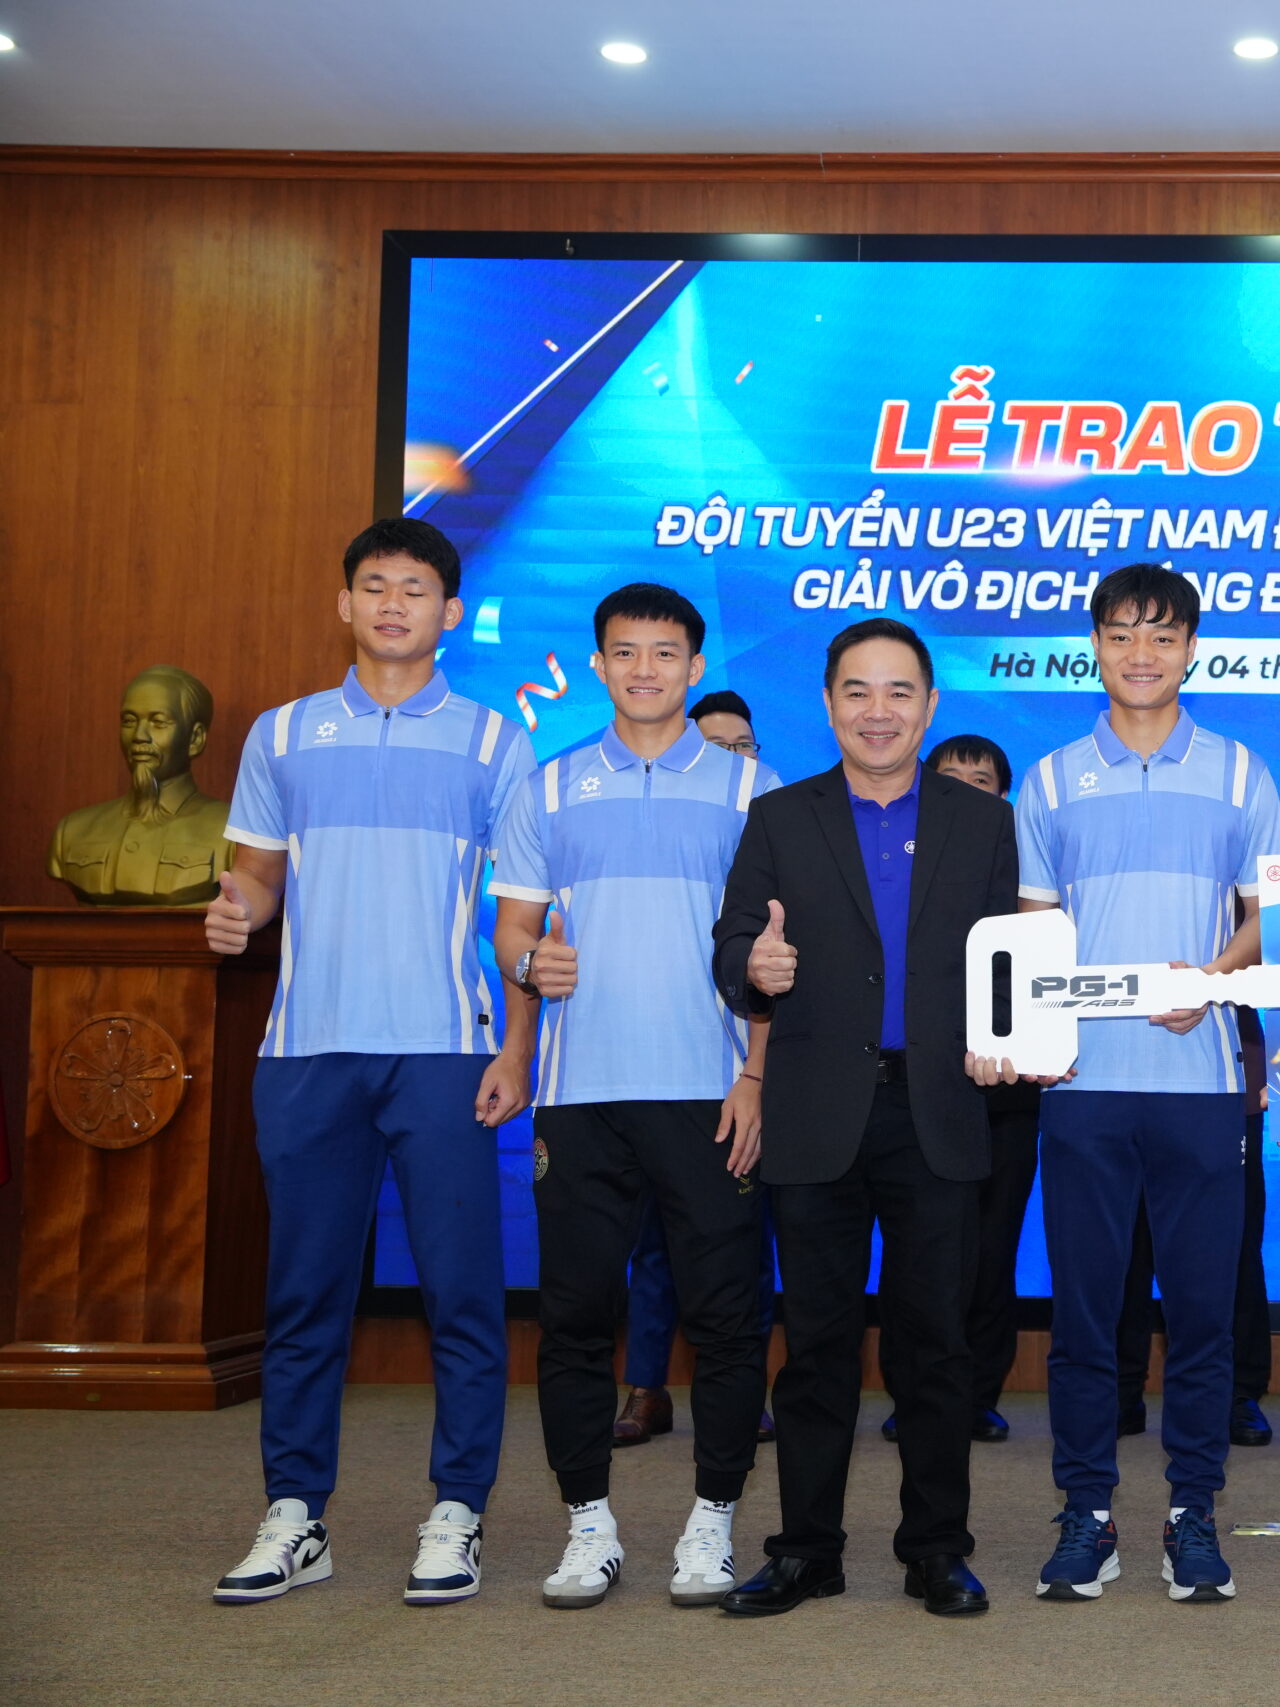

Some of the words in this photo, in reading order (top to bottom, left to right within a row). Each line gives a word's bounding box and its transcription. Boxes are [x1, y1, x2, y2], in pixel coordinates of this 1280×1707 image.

[871, 365, 995, 474] LỄ
[1003, 401, 1263, 476] TRAO
[656, 496, 746, 554] ĐỘI
[754, 489, 920, 547] TUYỂN
[926, 507, 1027, 548] U23
[1036, 498, 1145, 557] VIỆT
[1148, 509, 1268, 549] NAM
[793, 558, 891, 610] GIẢI
[900, 560, 969, 610] VÔ
[975, 570, 1099, 619] ĐỊCH
[989, 653, 1035, 678] Hà
[1207, 654, 1250, 679] 04
[1031, 974, 1139, 998] PG-1
[1081, 999, 1137, 1007] ABS
